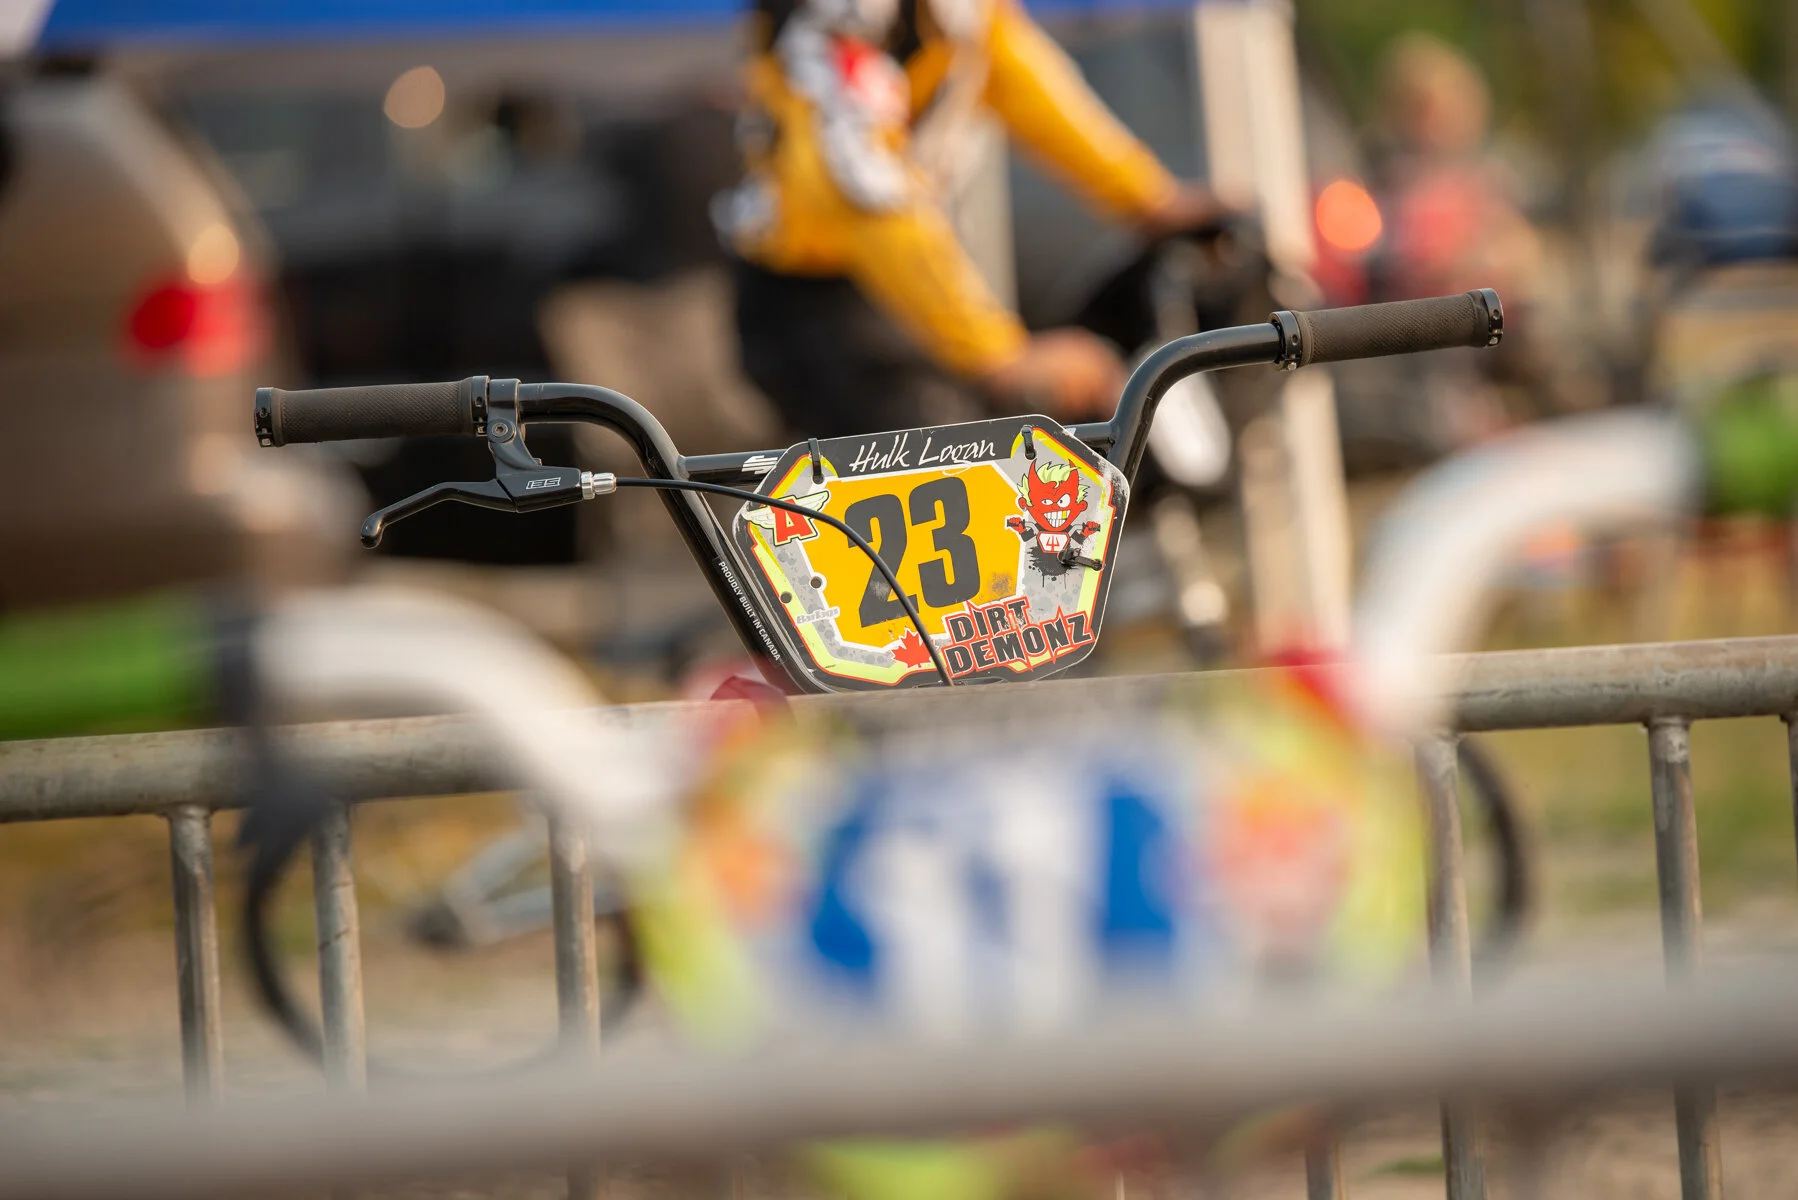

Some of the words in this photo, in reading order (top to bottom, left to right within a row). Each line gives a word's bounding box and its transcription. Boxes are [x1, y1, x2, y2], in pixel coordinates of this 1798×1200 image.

[849, 432, 910, 473] Hulk
[918, 436, 996, 476] Logan
[844, 476, 981, 629] 23
[718, 561, 744, 596] PROUDLY
[738, 595, 756, 618] BUILT
[752, 619, 763, 629] IN
[758, 628, 781, 661] CANADA
[943, 611, 1095, 677] DEMONZ
[946, 598, 1030, 644] DIRT
